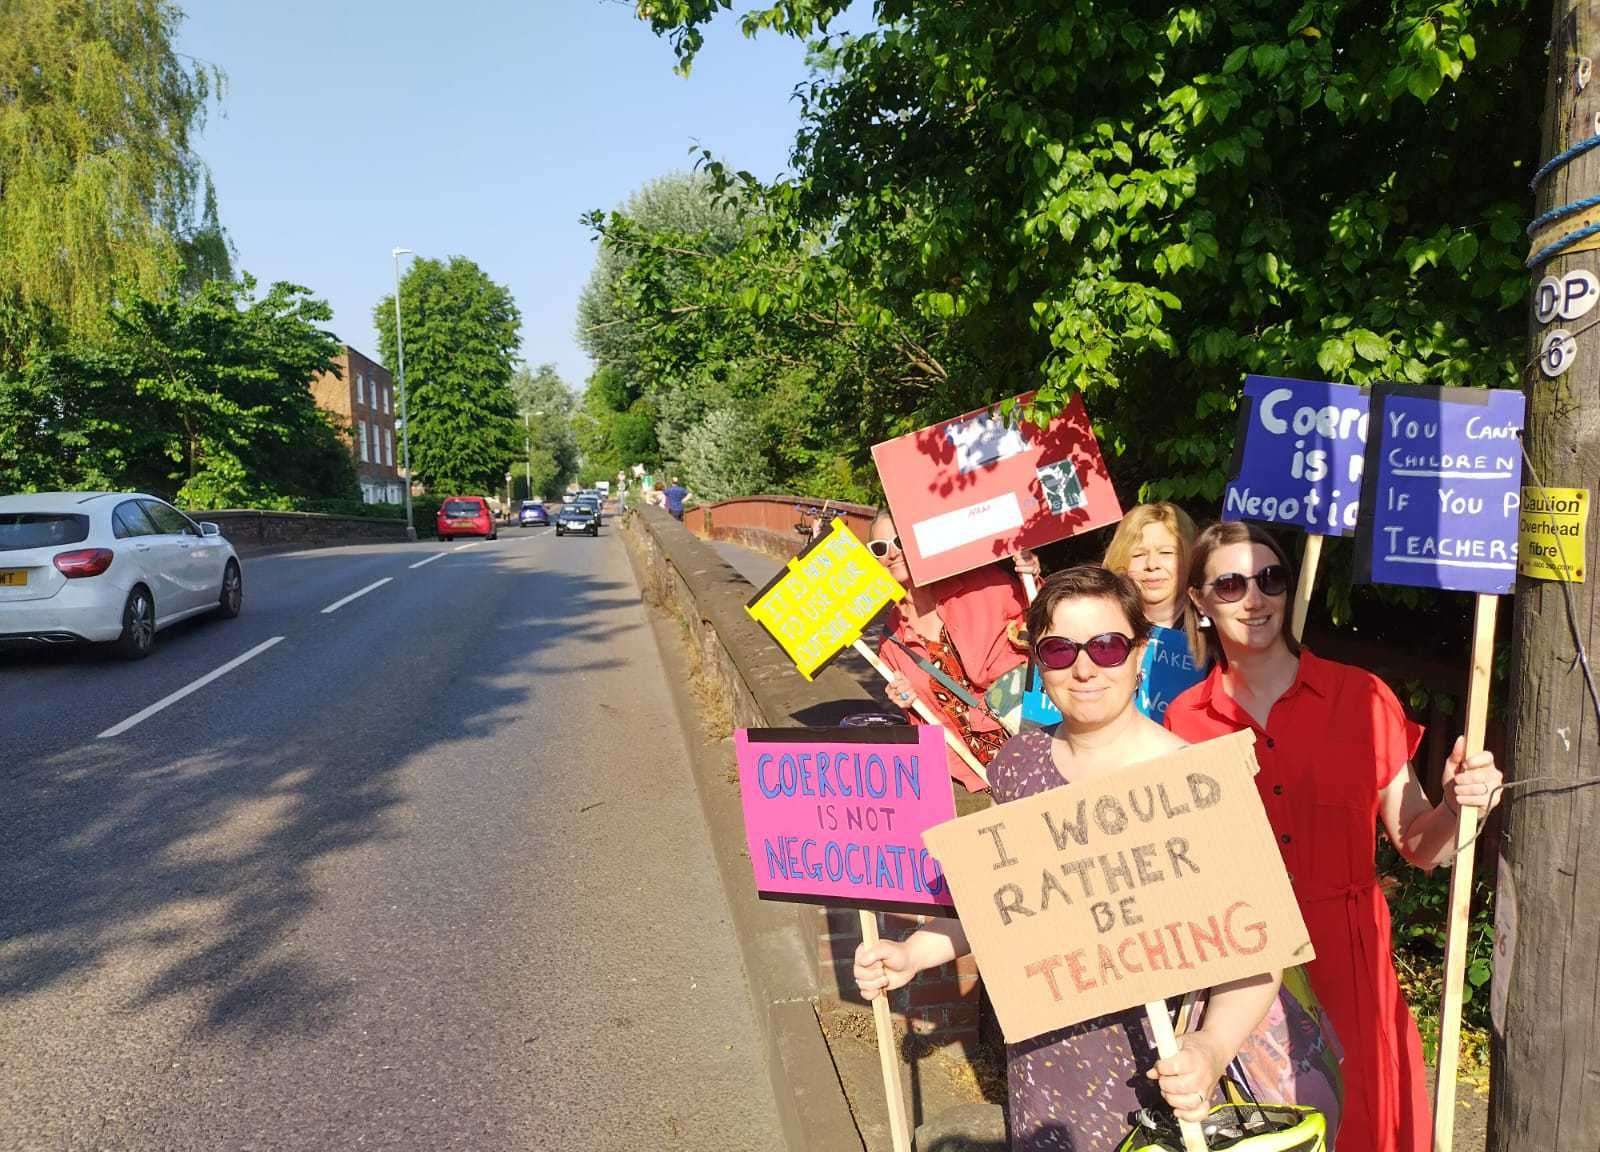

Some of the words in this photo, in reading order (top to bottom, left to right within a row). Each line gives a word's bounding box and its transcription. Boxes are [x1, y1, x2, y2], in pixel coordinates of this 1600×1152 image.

[1549, 337, 1563, 369] 6
[1291, 440, 1328, 482] is
[1389, 448, 1514, 470] CHILDREN
[1388, 487, 1410, 511] IF
[1523, 496, 1580, 513] Caution
[1520, 519, 1580, 536] Overhead
[1528, 541, 1557, 557] fibre
[757, 752, 921, 800] COERCION
[817, 804, 838, 830] IS
[846, 807, 895, 831] NOT
[977, 821, 1019, 871] I
[1041, 772, 1223, 851] WOULD
[764, 836, 943, 896] NEGOCIATIO
[993, 837, 1201, 926] RATHER
[1090, 896, 1144, 933] BE
[1023, 900, 1268, 1002] TEACHING
